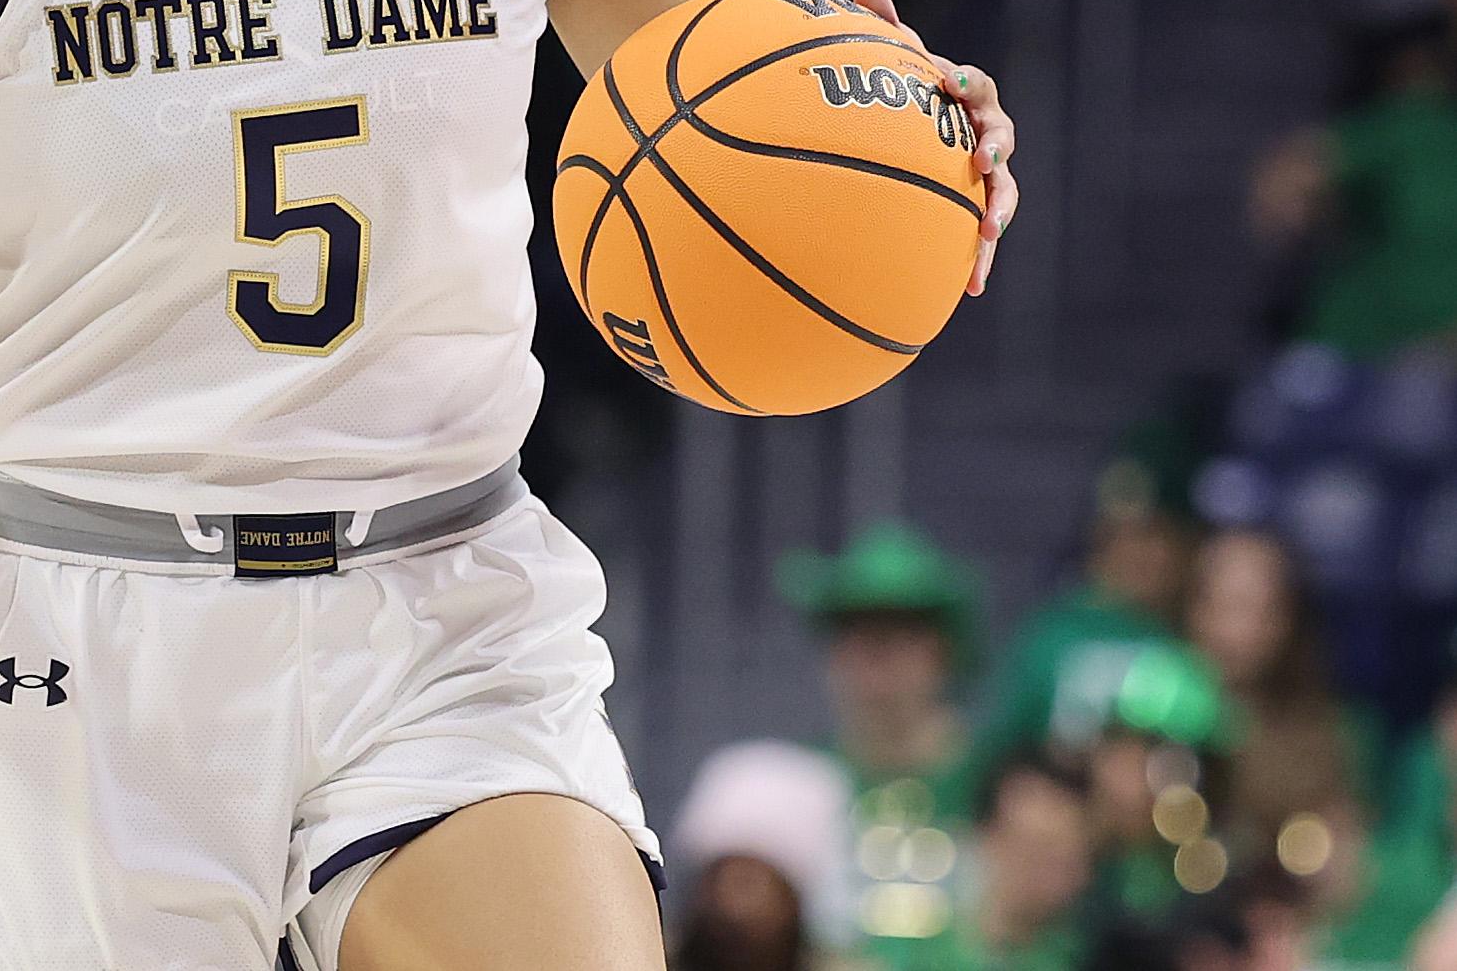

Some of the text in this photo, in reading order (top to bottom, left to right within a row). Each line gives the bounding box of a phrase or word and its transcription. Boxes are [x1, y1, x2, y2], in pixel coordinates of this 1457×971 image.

[226, 94, 371, 357] 5
[240, 530, 330, 546] NOTRE DAME
